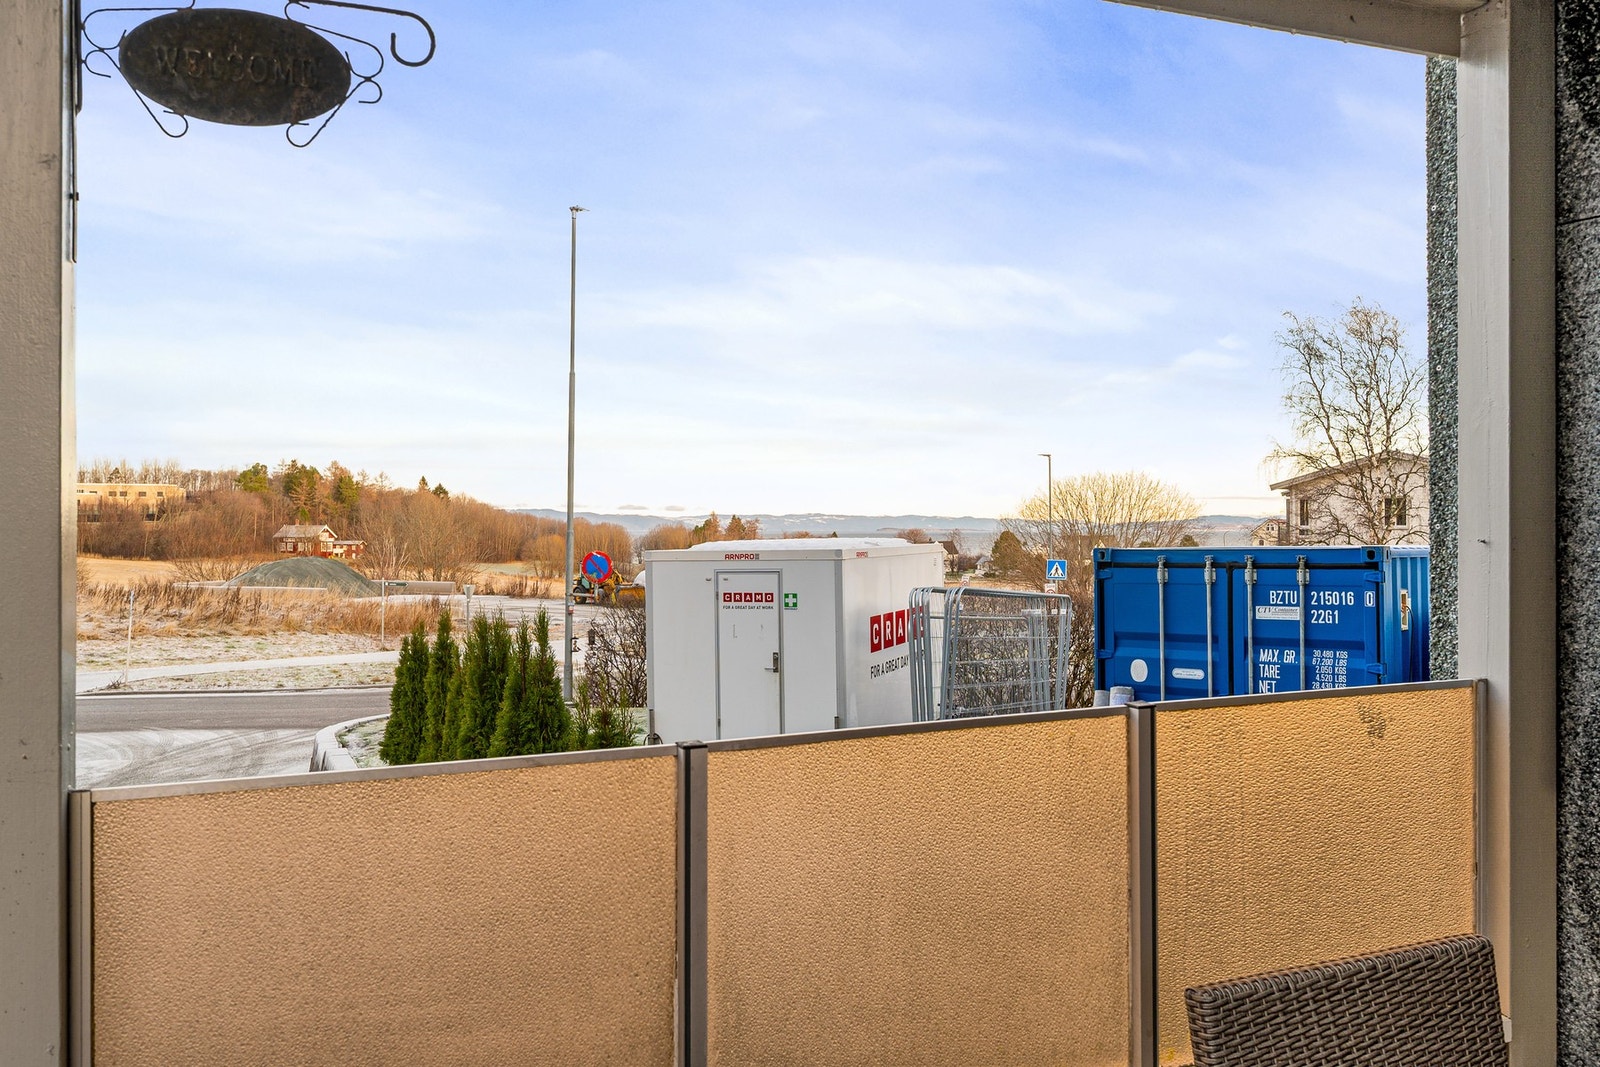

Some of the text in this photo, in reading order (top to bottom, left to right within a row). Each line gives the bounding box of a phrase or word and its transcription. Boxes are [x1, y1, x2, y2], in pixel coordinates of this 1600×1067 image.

[724, 594, 773, 602] CRAMO
[1269, 590, 1374, 606] BZTU 215016 0
[1310, 609, 1339, 624] 22G1
[871, 611, 924, 646] CRA
[1259, 648, 1298, 664] MAX. GR.
[1312, 649, 1348, 658] 30.480 KGS
[870, 664, 881, 679] FOR
[881, 662, 885, 676] A
[885, 657, 900, 674] GREAT
[1312, 658, 1347, 667] 67.200 LBS
[1259, 664, 1280, 679] TARE
[1315, 666, 1347, 675] 2.050 KGS
[1315, 674, 1347, 683] 4.520 LBS
[1259, 680, 1276, 693] NET
